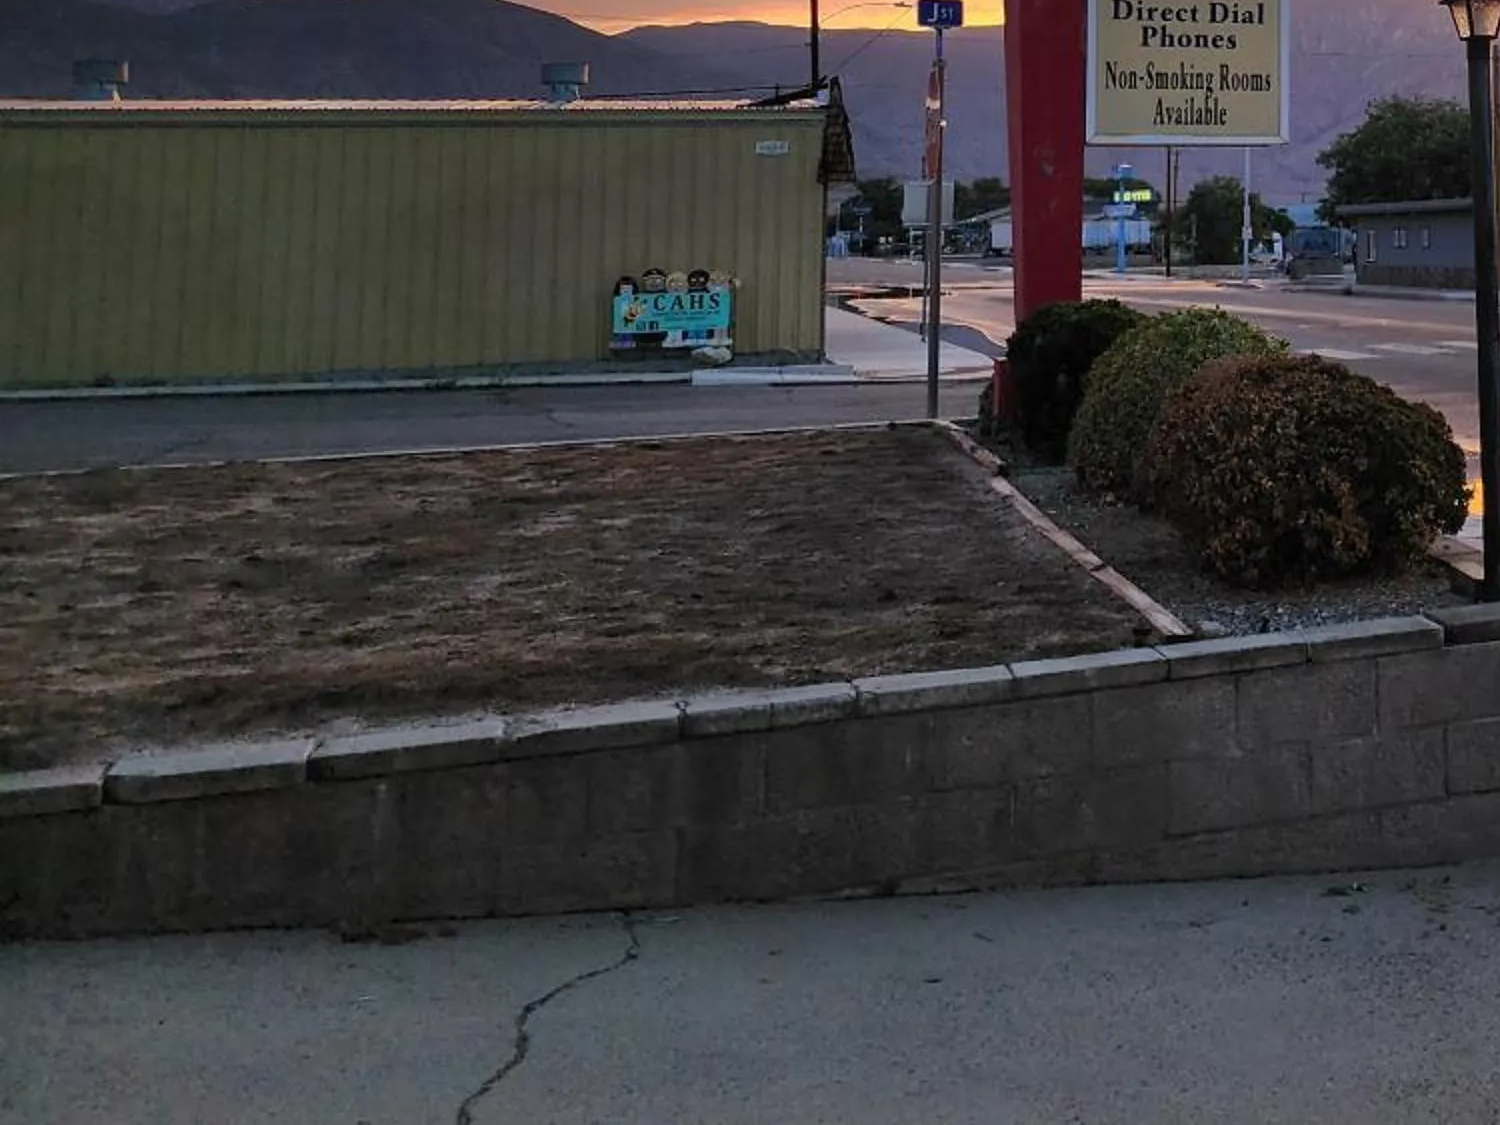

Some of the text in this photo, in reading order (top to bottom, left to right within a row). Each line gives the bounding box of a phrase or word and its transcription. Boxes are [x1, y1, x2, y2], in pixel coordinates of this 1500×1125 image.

[1209, 2, 1264, 25] Dial
[1140, 26, 1237, 50] Phones
[1105, 60, 1271, 99] Non-Smoking Rooms
[1153, 97, 1228, 126] Available
[653, 292, 722, 312] CAHS
